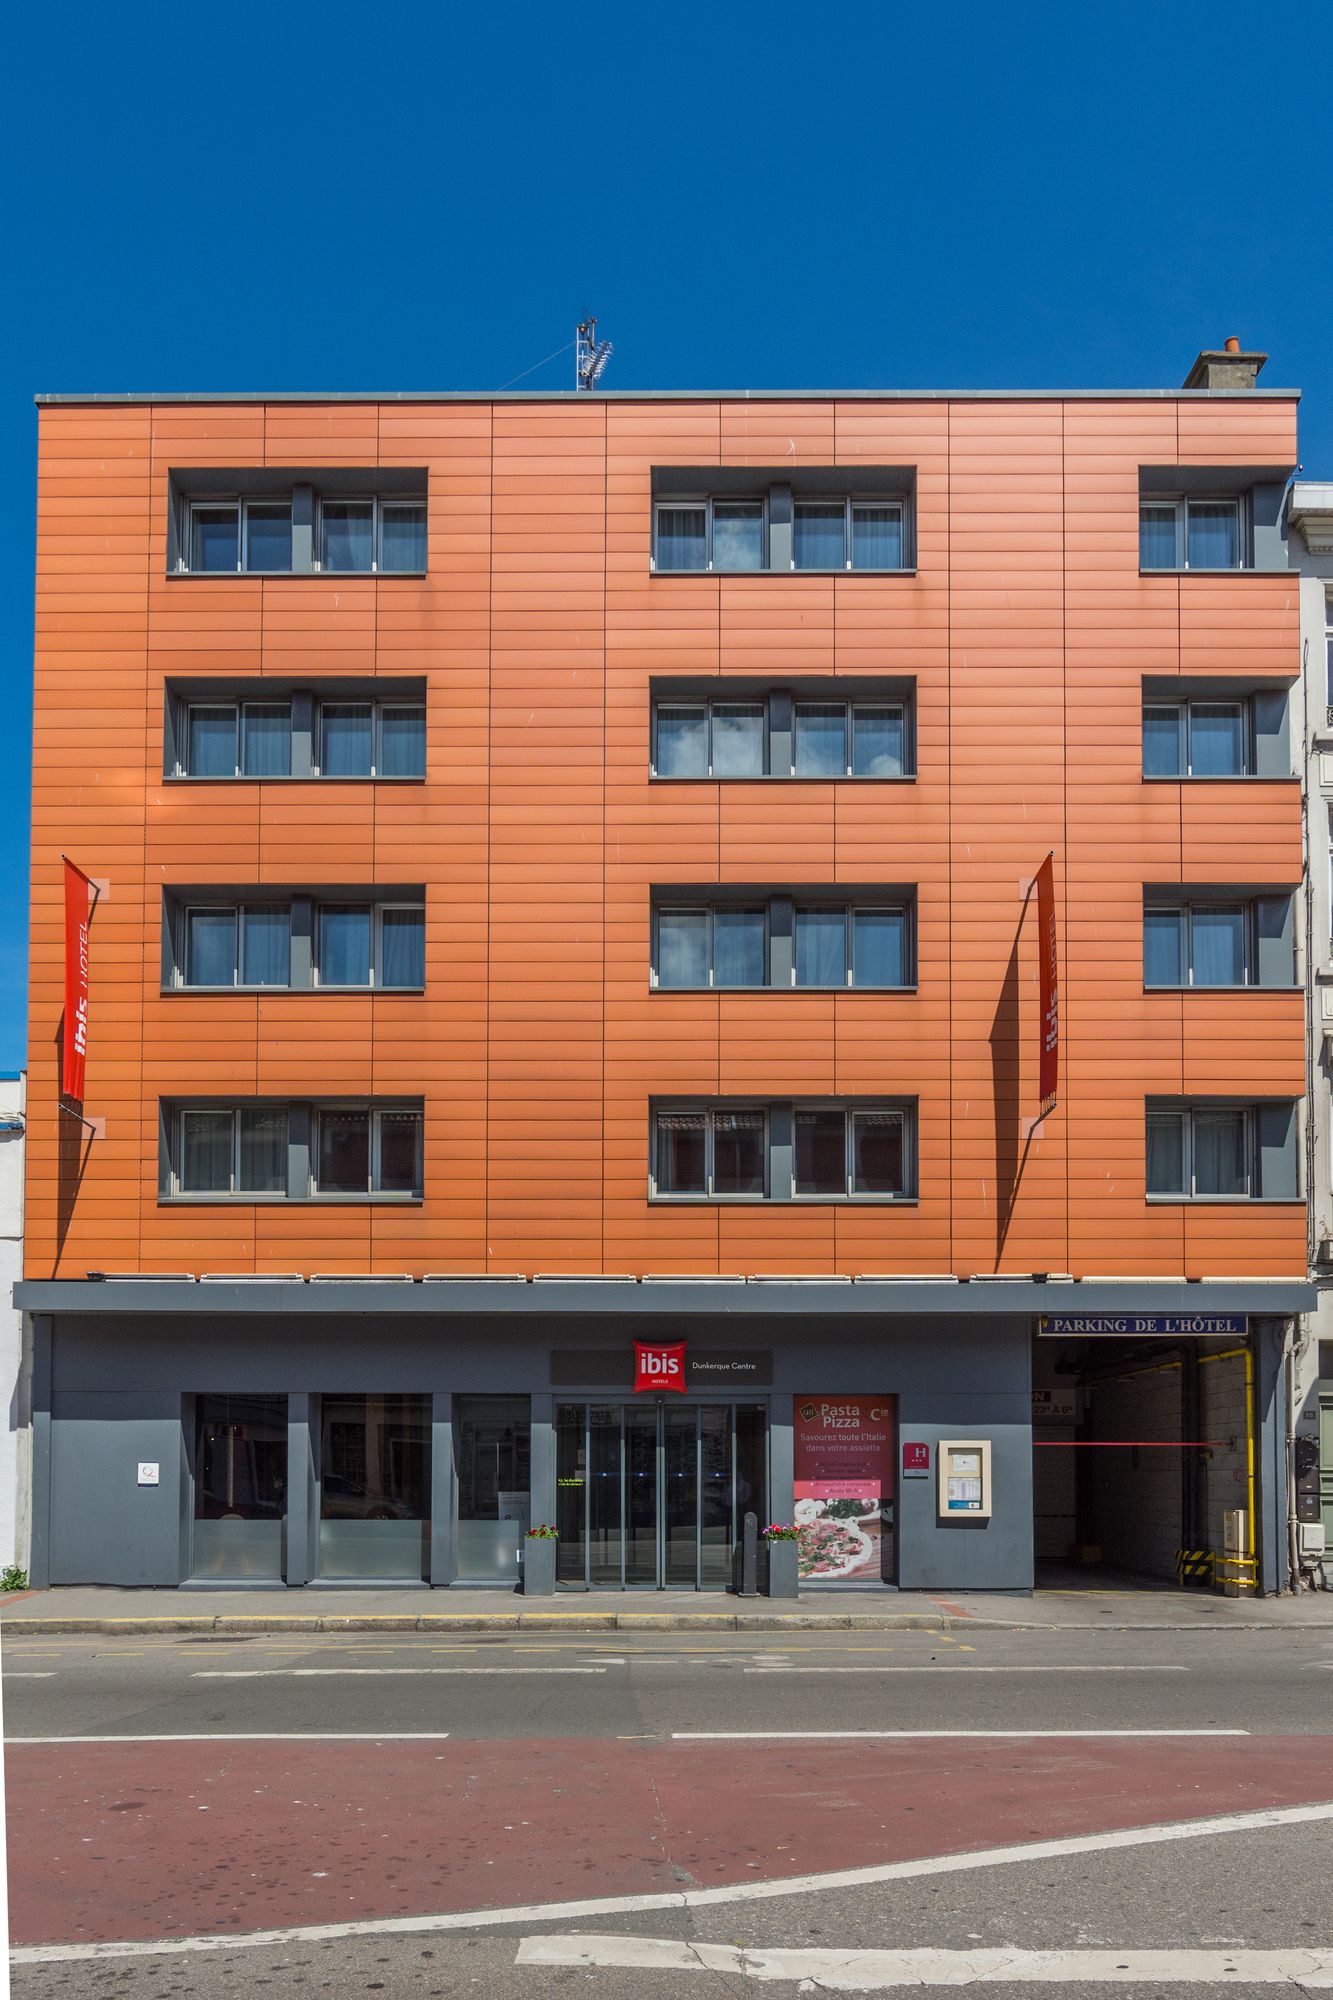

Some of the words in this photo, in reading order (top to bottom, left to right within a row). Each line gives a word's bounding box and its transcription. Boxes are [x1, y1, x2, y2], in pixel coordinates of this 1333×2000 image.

[79, 921, 89, 988] HOTEL
[74, 996, 88, 1056] ibis
[1046, 988, 1058, 1052] ibis
[1053, 1319, 1127, 1332] PARKING
[1134, 1319, 1157, 1332] DE
[1165, 1316, 1237, 1332] L'HÔTEL
[640, 1352, 679, 1374] ibis
[692, 1362, 730, 1371] Dunkerque
[731, 1362, 756, 1370] Centre
[821, 1403, 860, 1416] Pasta
[823, 1415, 860, 1428] Pizza
[800, 1433, 837, 1441] Savourez
[838, 1433, 860, 1441] toute
[861, 1433, 887, 1441] l'Italie
[806, 1444, 826, 1452] dans
[826, 1444, 848, 1452] votre
[849, 1444, 881, 1452] assiette
[915, 1447, 926, 1457] H
